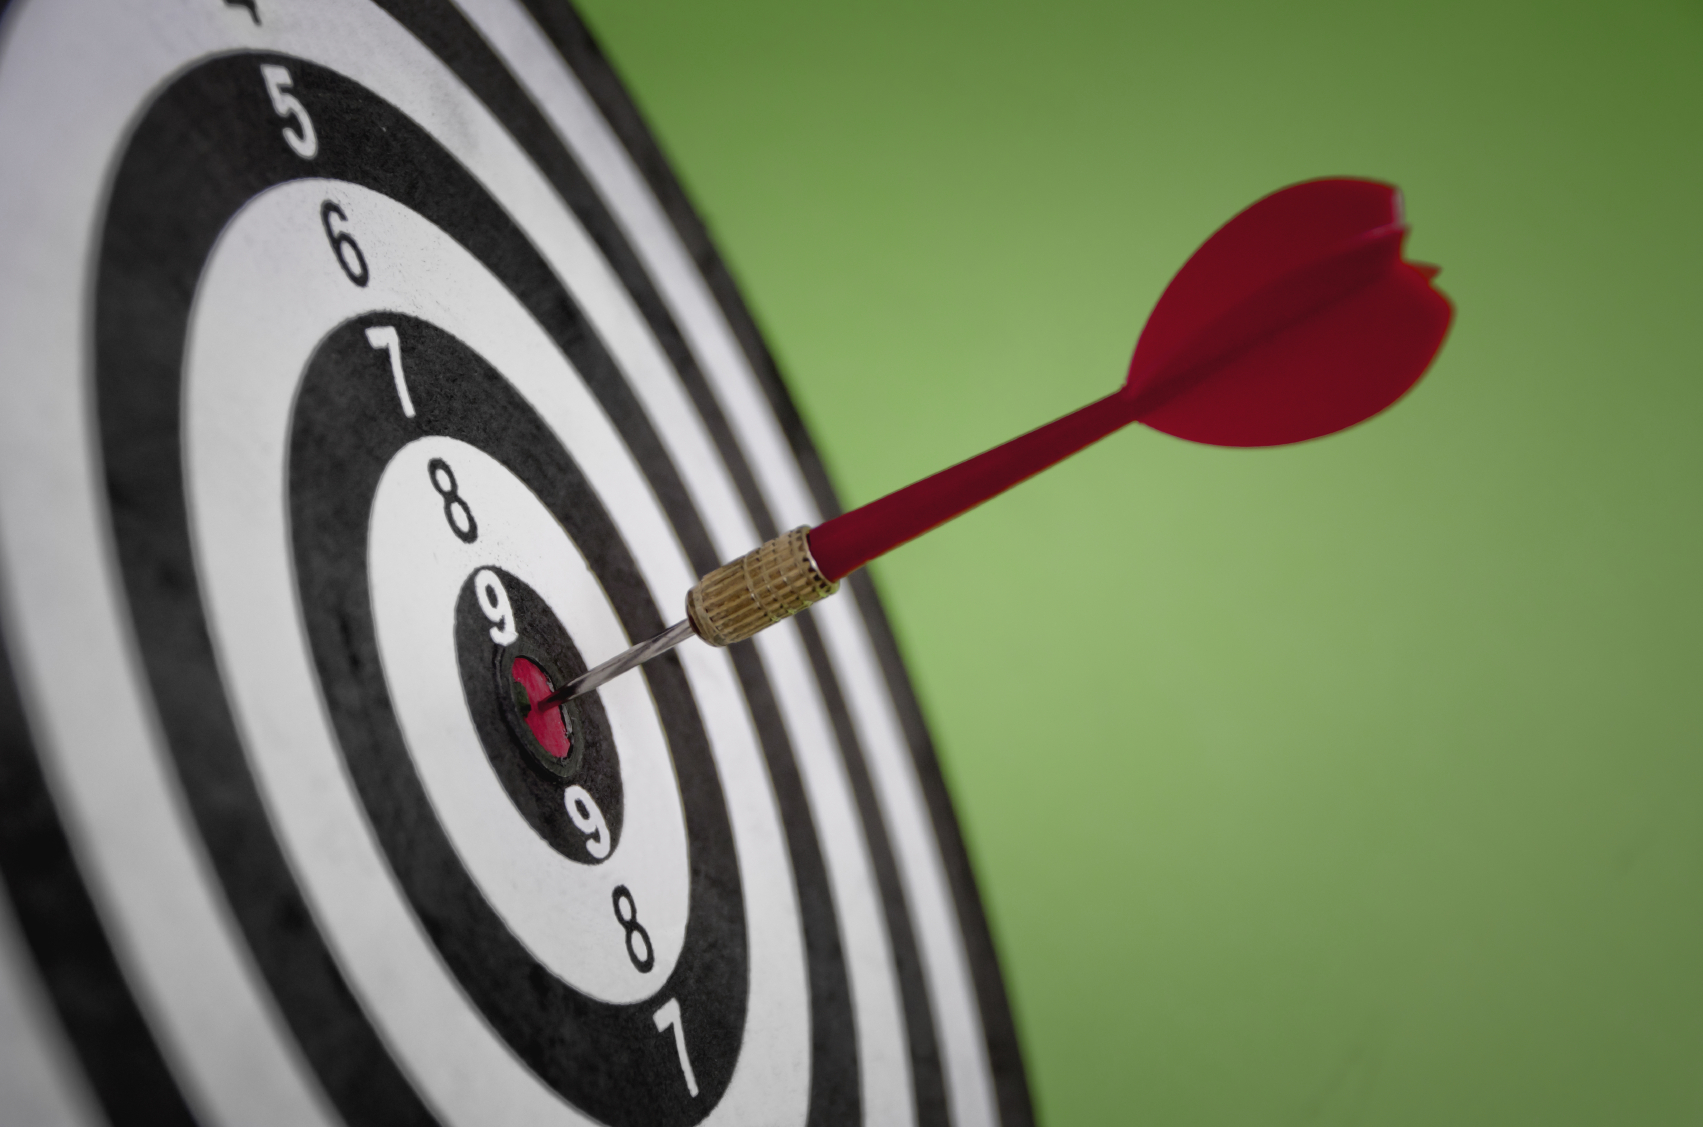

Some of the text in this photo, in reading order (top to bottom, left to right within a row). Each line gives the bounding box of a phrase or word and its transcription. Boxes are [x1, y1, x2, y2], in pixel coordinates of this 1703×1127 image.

[260, 64, 318, 160] 5
[319, 199, 370, 289] 6
[365, 325, 416, 418] 7
[427, 457, 479, 545] 8
[474, 569, 519, 647] 9
[563, 784, 612, 860] 9
[611, 884, 655, 974] 8
[652, 997, 699, 1098] 7
